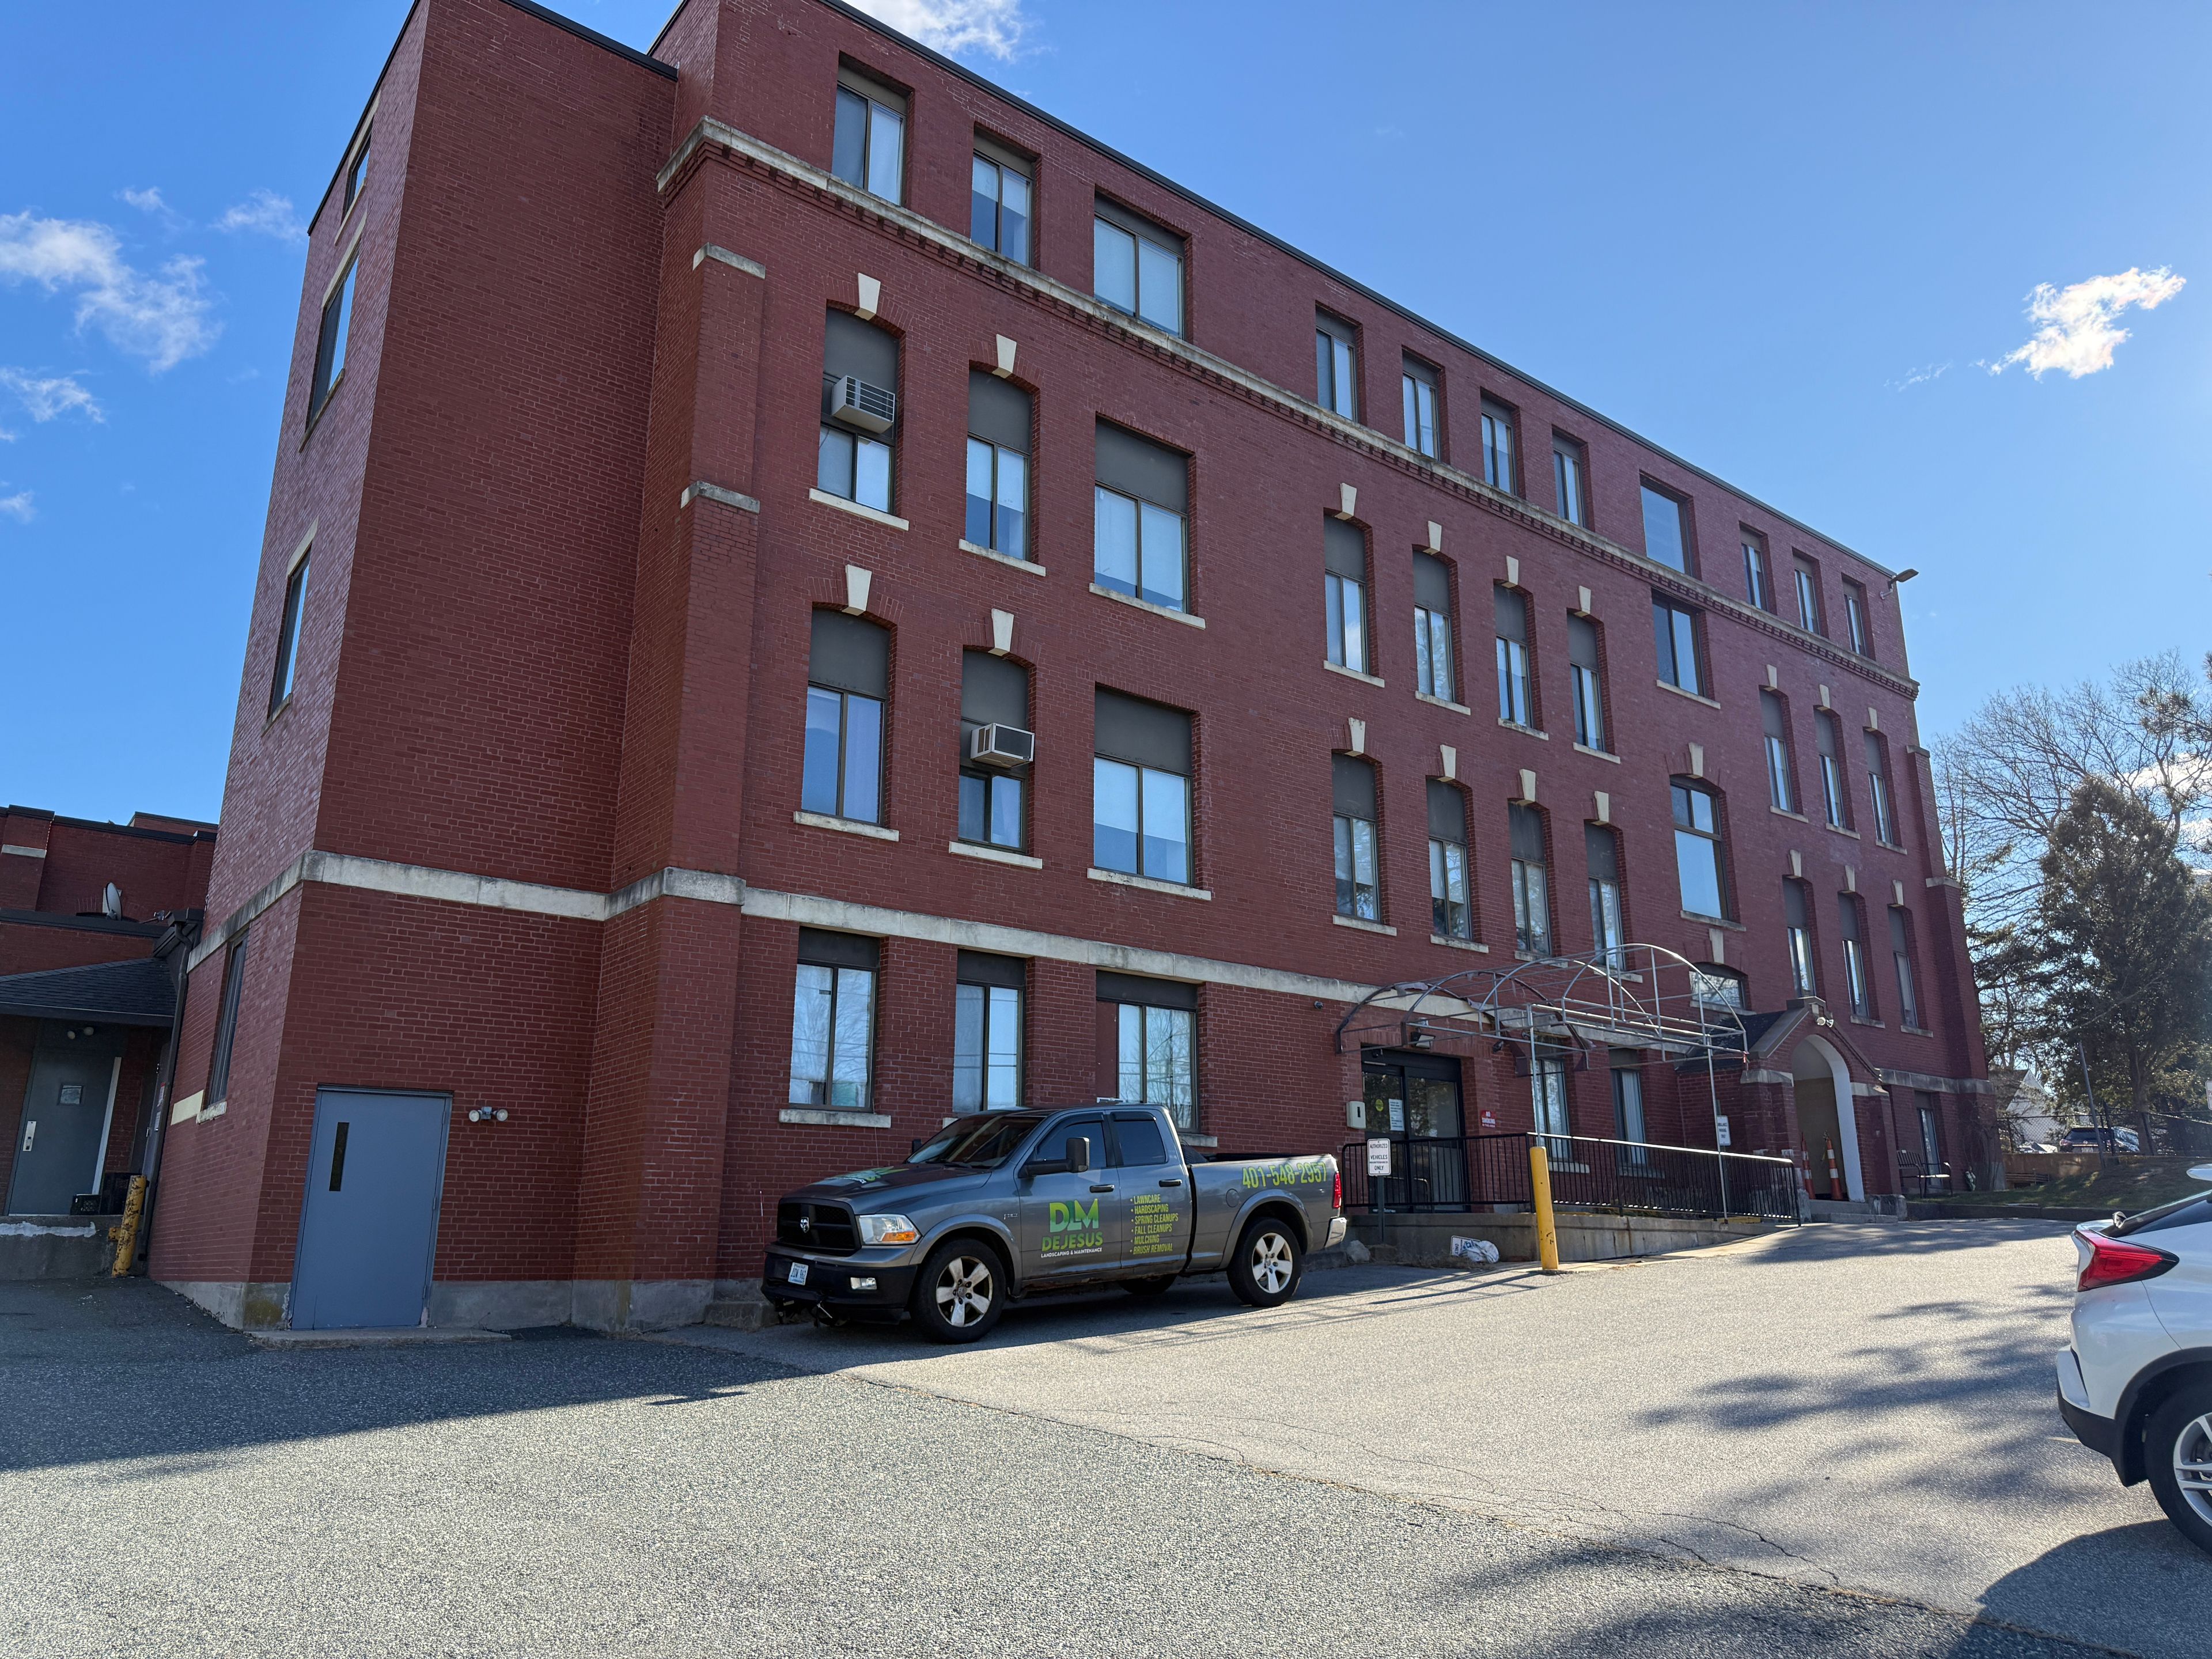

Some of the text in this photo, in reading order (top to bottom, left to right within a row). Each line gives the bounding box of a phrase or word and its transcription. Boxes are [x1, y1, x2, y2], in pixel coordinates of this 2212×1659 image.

[1243, 1161, 1326, 1188] 401-548-2957
[1134, 1194, 1161, 1205] LAWNCARE
[1134, 1203, 1169, 1214] HARDSCAPING
[1135, 1213, 1179, 1225] SPRING CLEANUPS
[1135, 1223, 1172, 1234] FALL CLEANUPS
[1041, 1232, 1103, 1251] DEJESUS
[1134, 1234, 1160, 1244] MULCHING
[1133, 1243, 1173, 1255] BRUSH REMOVAL
